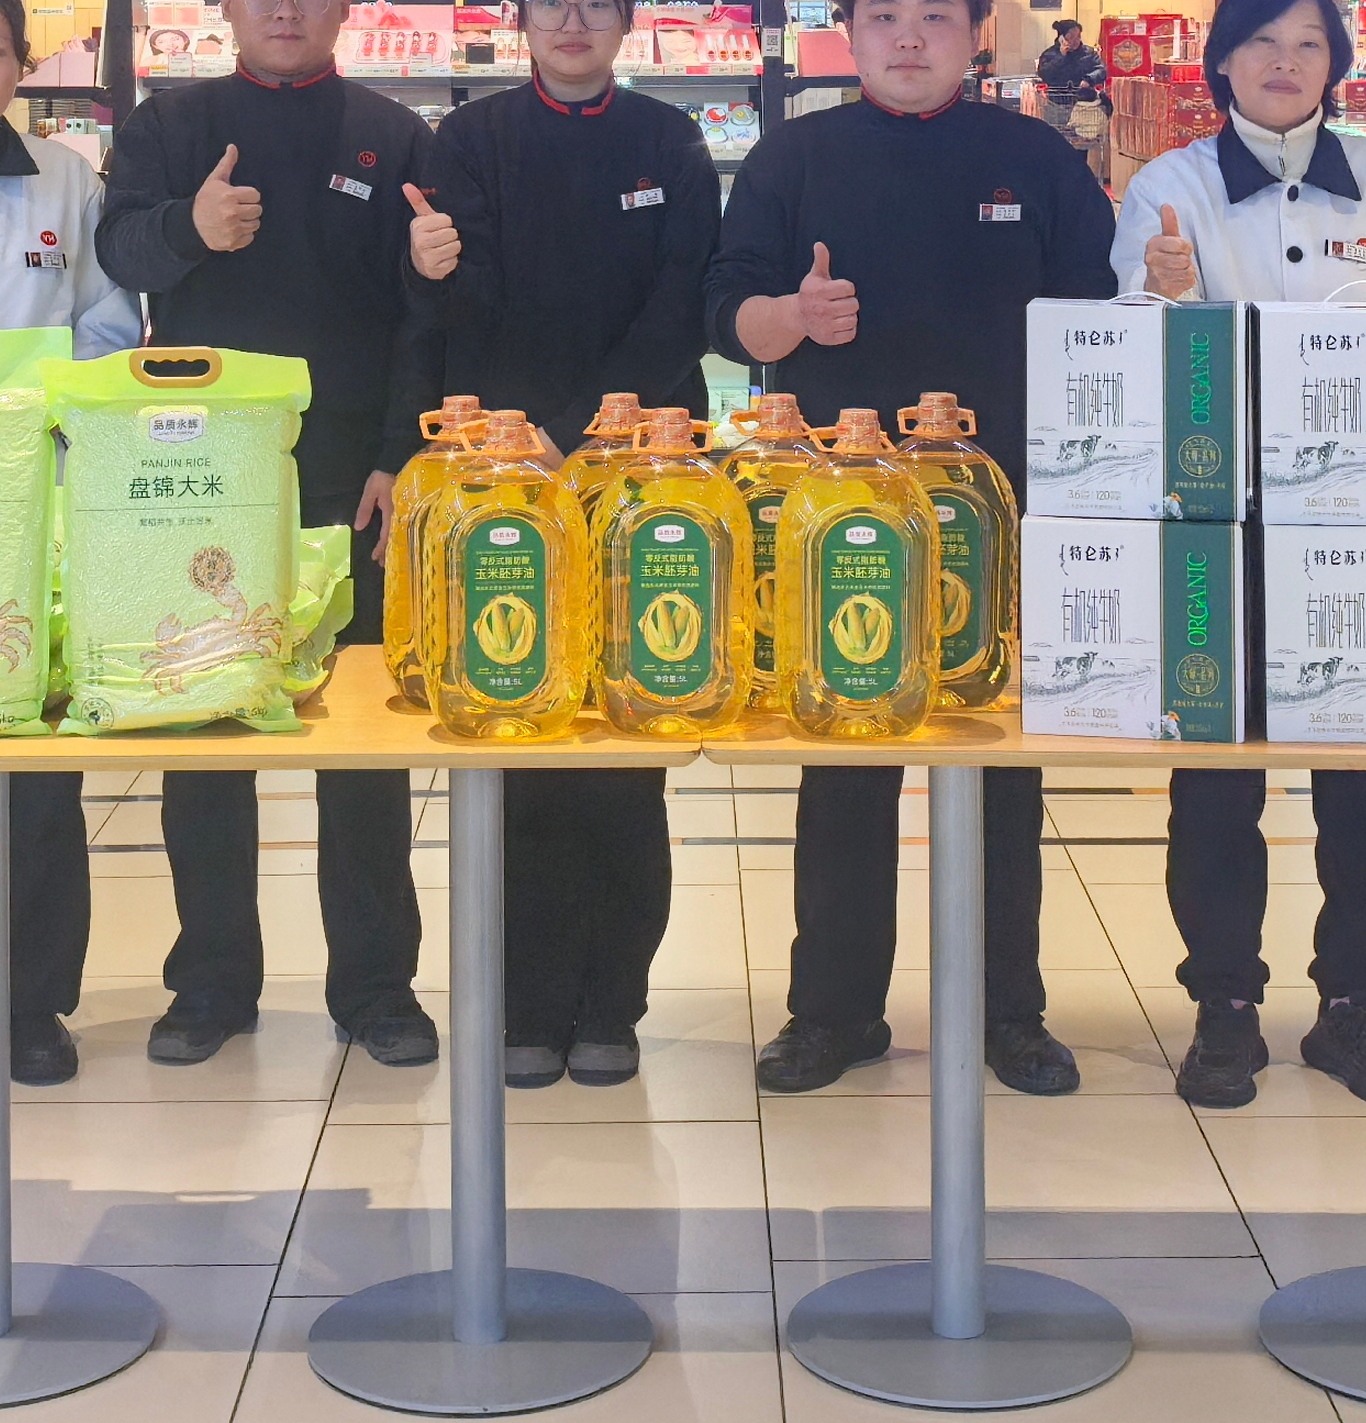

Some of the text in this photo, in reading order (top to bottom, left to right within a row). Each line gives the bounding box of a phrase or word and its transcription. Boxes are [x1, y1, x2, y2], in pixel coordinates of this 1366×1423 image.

[1074, 330, 1116, 346] 特仑苏
[1310, 335, 1352, 350] 特仑苏
[1191, 332, 1212, 425] ORGANIC
[153, 419, 198, 431] 品质永辉
[141, 457, 212, 468] PANJIN RICE
[129, 474, 224, 500] 盘锦大米
[1069, 545, 1111, 561] 特仑苏
[1314, 549, 1356, 565] 特仑苏
[474, 567, 535, 580] 玉米胚芽油
[640, 564, 700, 577] 玉米胚芽油
[831, 566, 891, 579] 玉米胚芽油
[1186, 551, 1208, 646] ORGANIC
